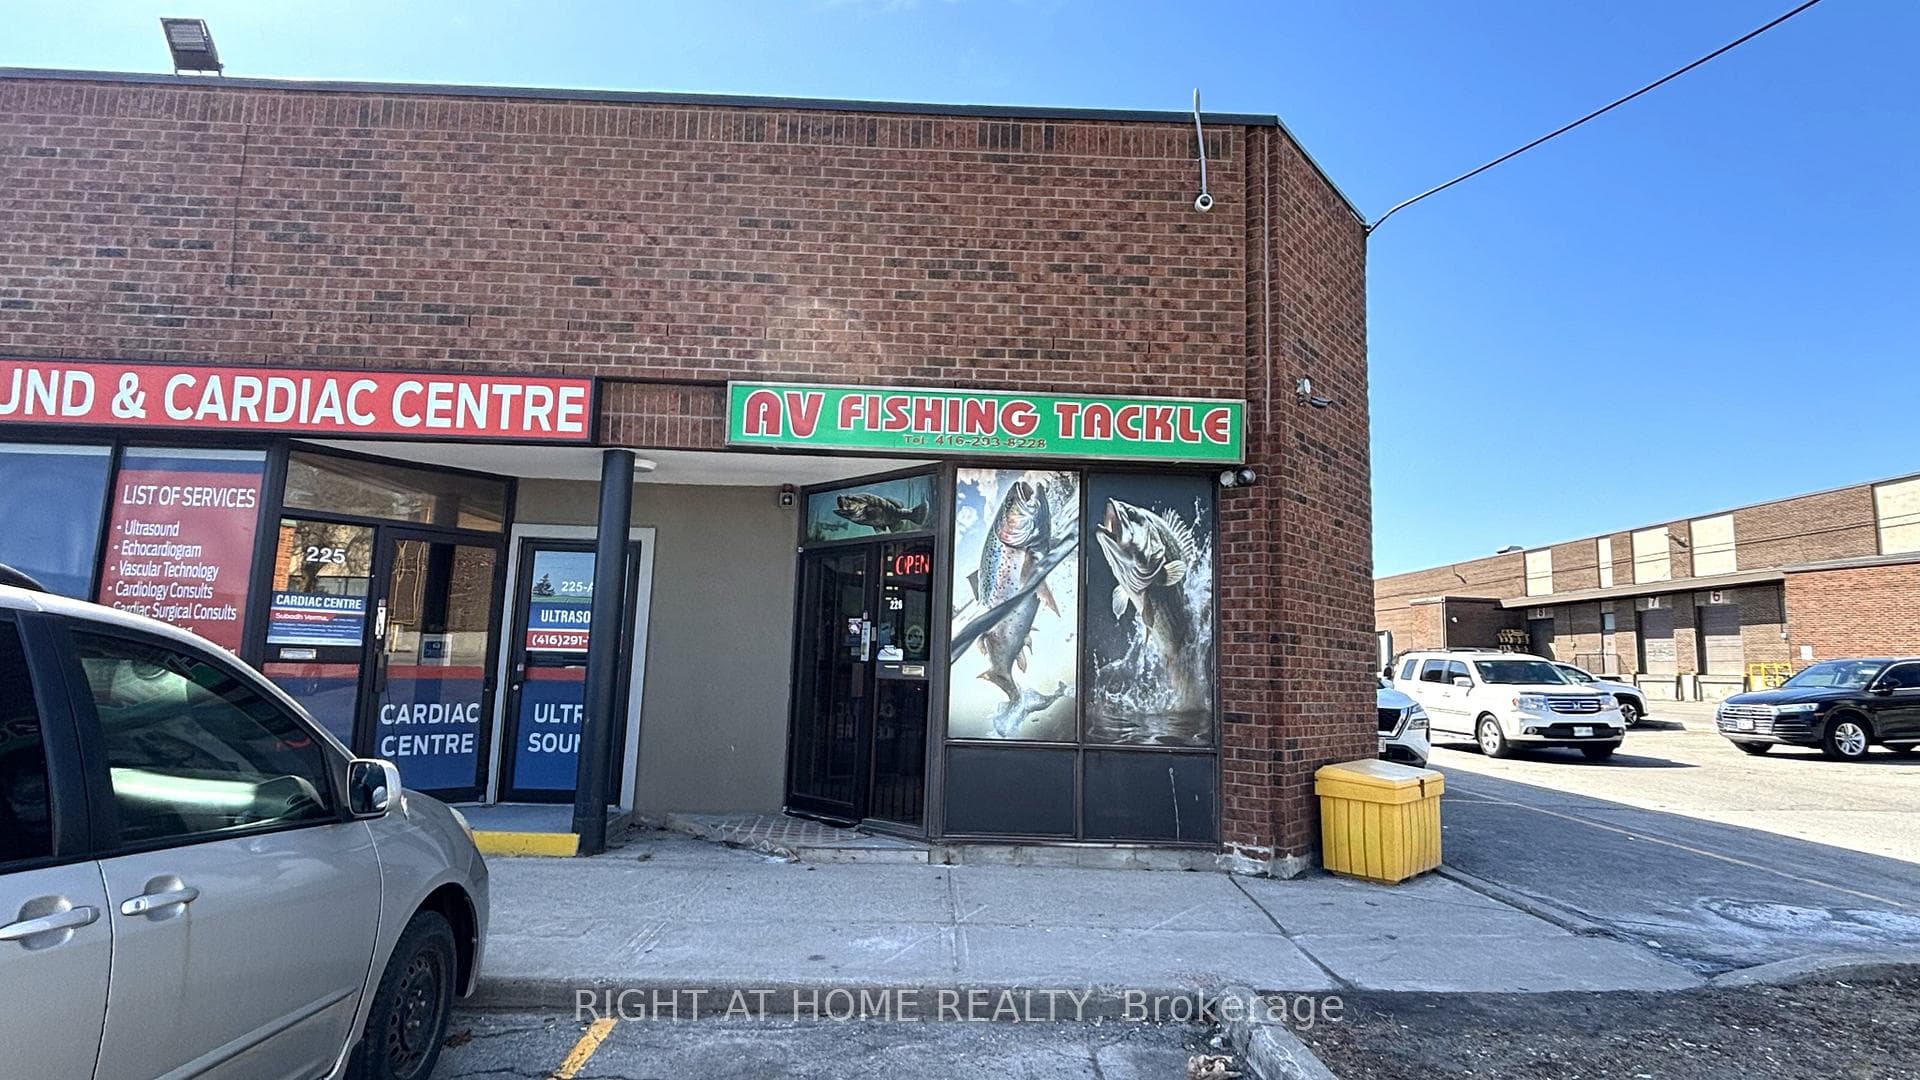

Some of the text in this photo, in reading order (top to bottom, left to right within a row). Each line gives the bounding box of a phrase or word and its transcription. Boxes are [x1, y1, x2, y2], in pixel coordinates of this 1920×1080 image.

[0, 368, 585, 433] UND & CARDIAC CENTRE
[743, 389, 1231, 445] AV FISHING TACKLE
[122, 485, 256, 508] LIST OF SERVICES
[124, 519, 180, 537] Ultrasound
[121, 540, 202, 560] Echocardiogram
[306, 546, 346, 564] 225
[119, 560, 220, 582] Vascular Technology
[895, 554, 930, 576] OPEN
[115, 580, 214, 601] Cardiology Consults
[151, 602, 192, 621] Surgical
[193, 603, 237, 620] Consults
[276, 594, 362, 610] CARDIAC CENTRE
[541, 609, 592, 624] ULTRASO
[532, 634, 590, 647] (416)291-
[380, 703, 480, 725] CARDIAC
[534, 703, 584, 724] ULTR
[381, 733, 474, 757] CENTRE
